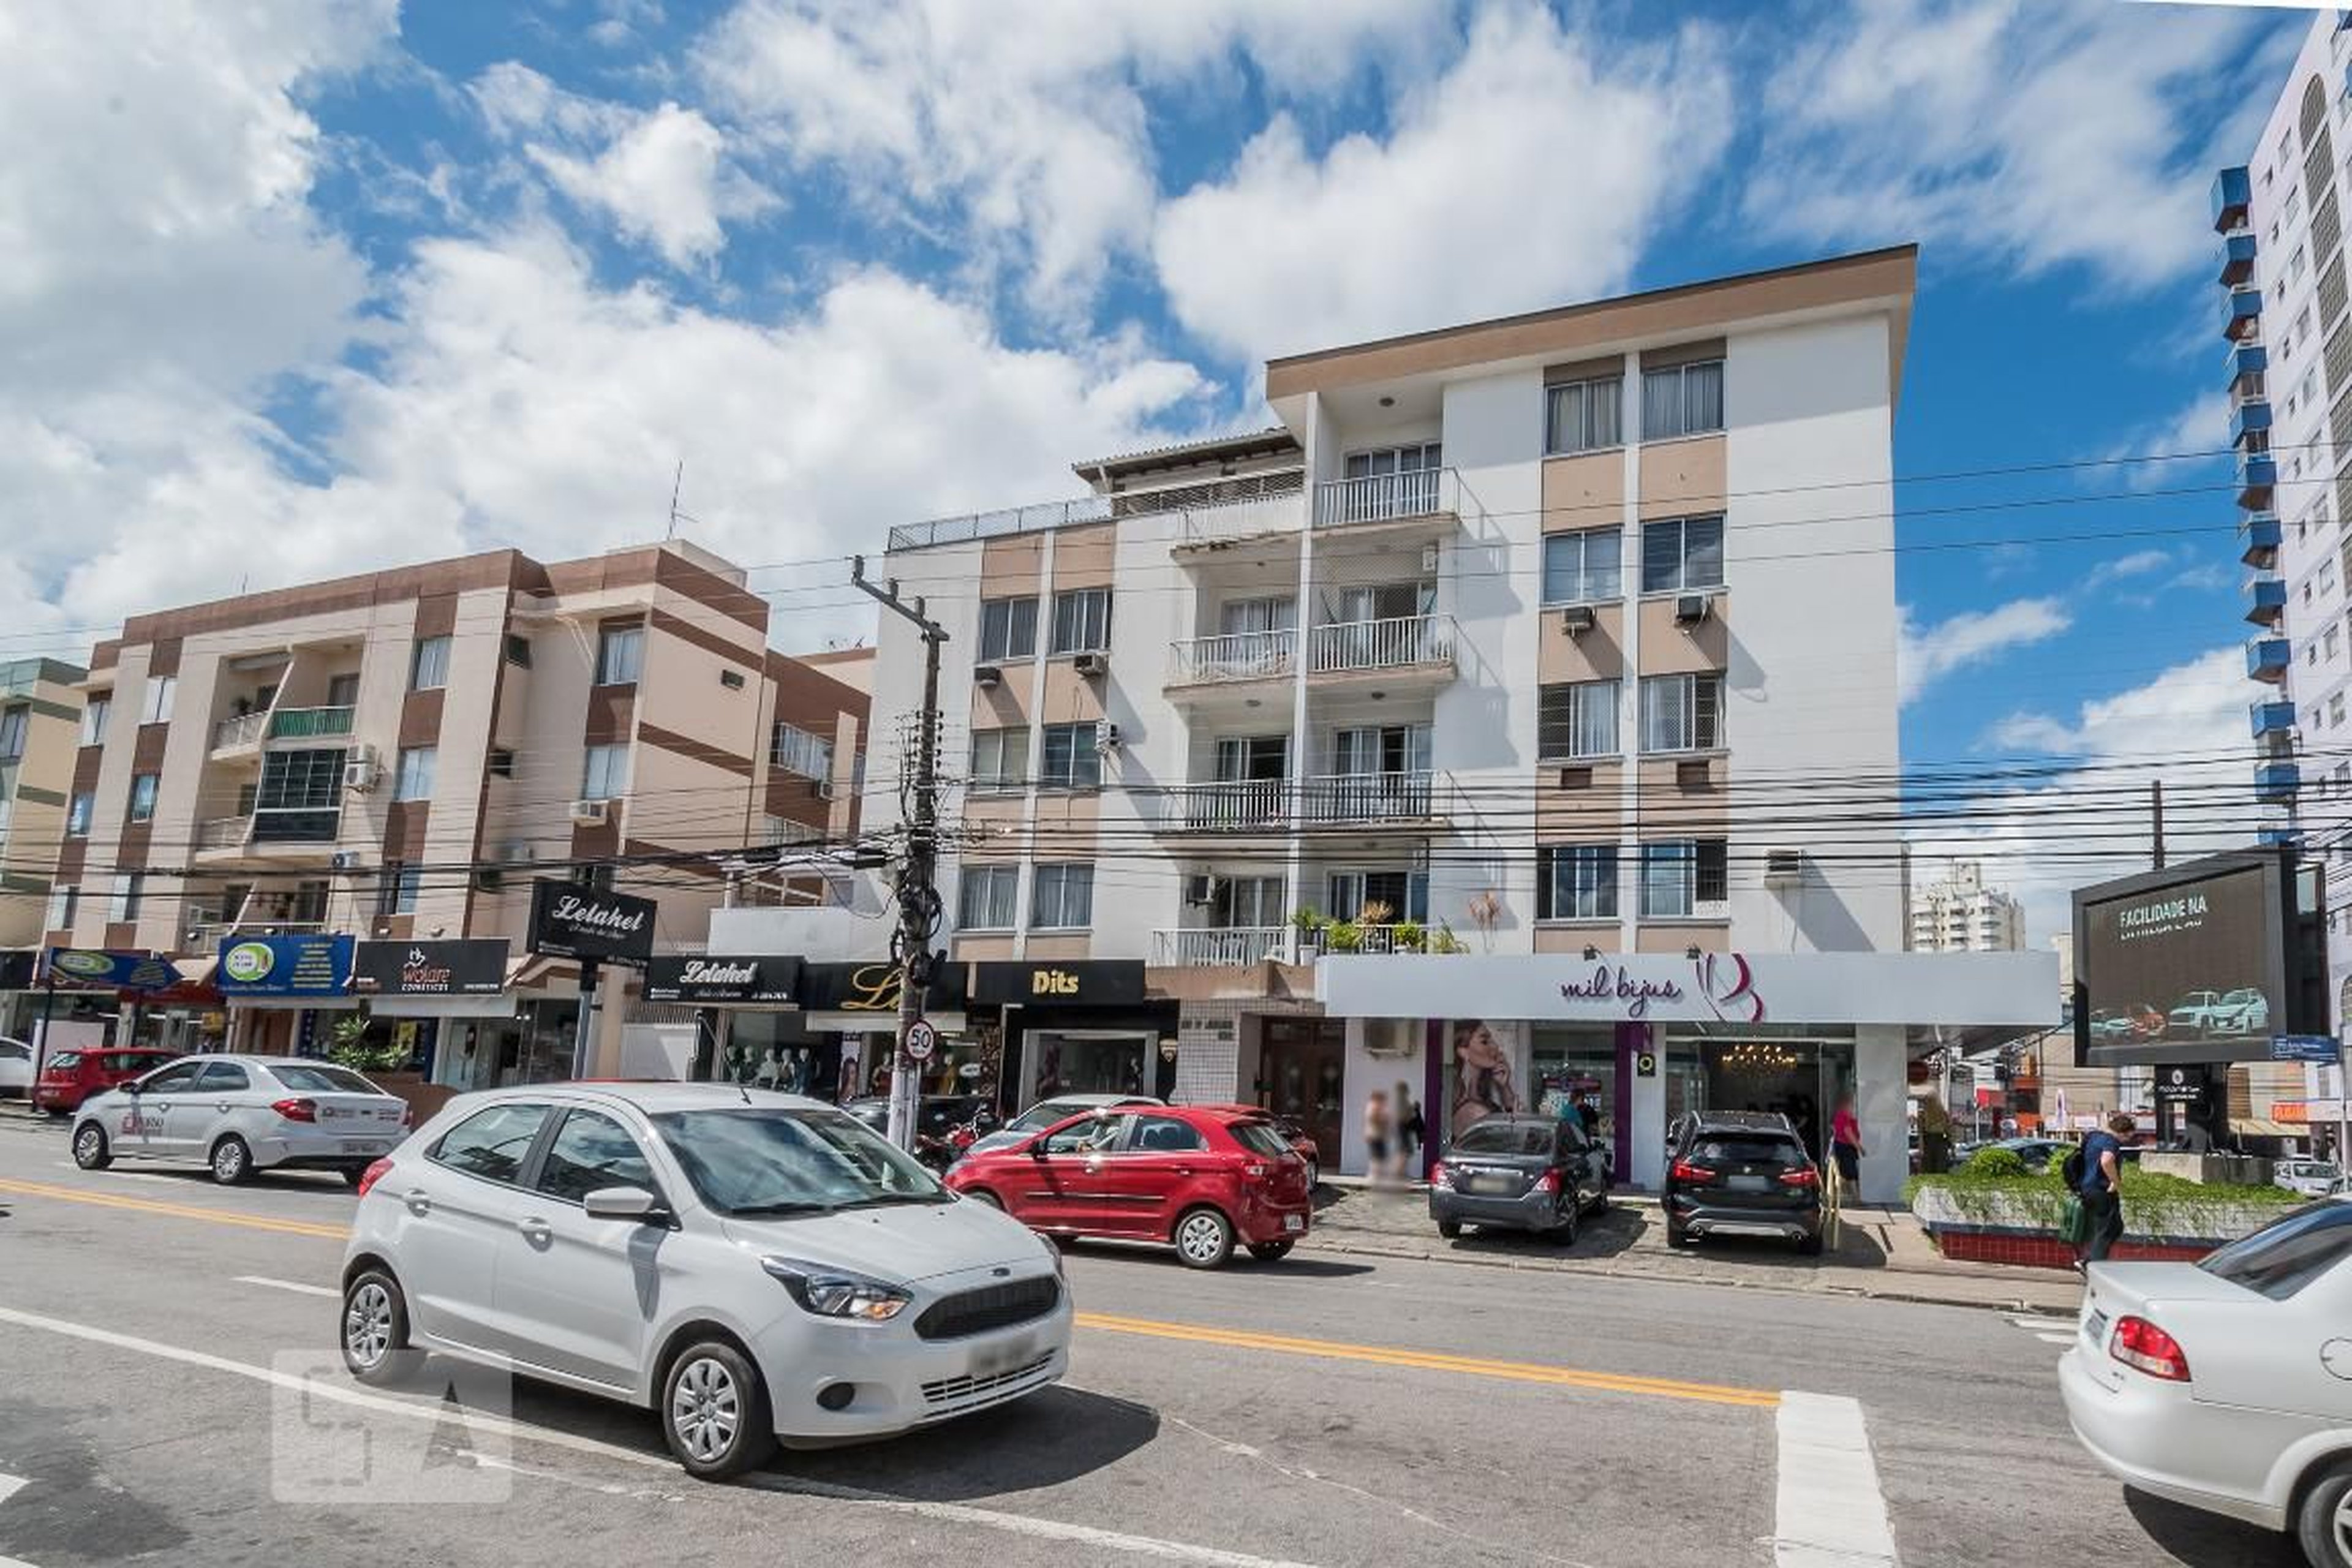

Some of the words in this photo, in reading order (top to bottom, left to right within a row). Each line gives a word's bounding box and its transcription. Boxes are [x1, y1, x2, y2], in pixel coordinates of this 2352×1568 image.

[552, 895, 644, 931] Lelahel
[2120, 899, 2186, 927] FACILIDADE
[679, 960, 758, 984] Lelahel
[1032, 970, 1079, 994] Dits
[1561, 966, 1612, 998] mil
[1616, 965, 1681, 1018] bijus
[910, 1028, 932, 1048] 50
